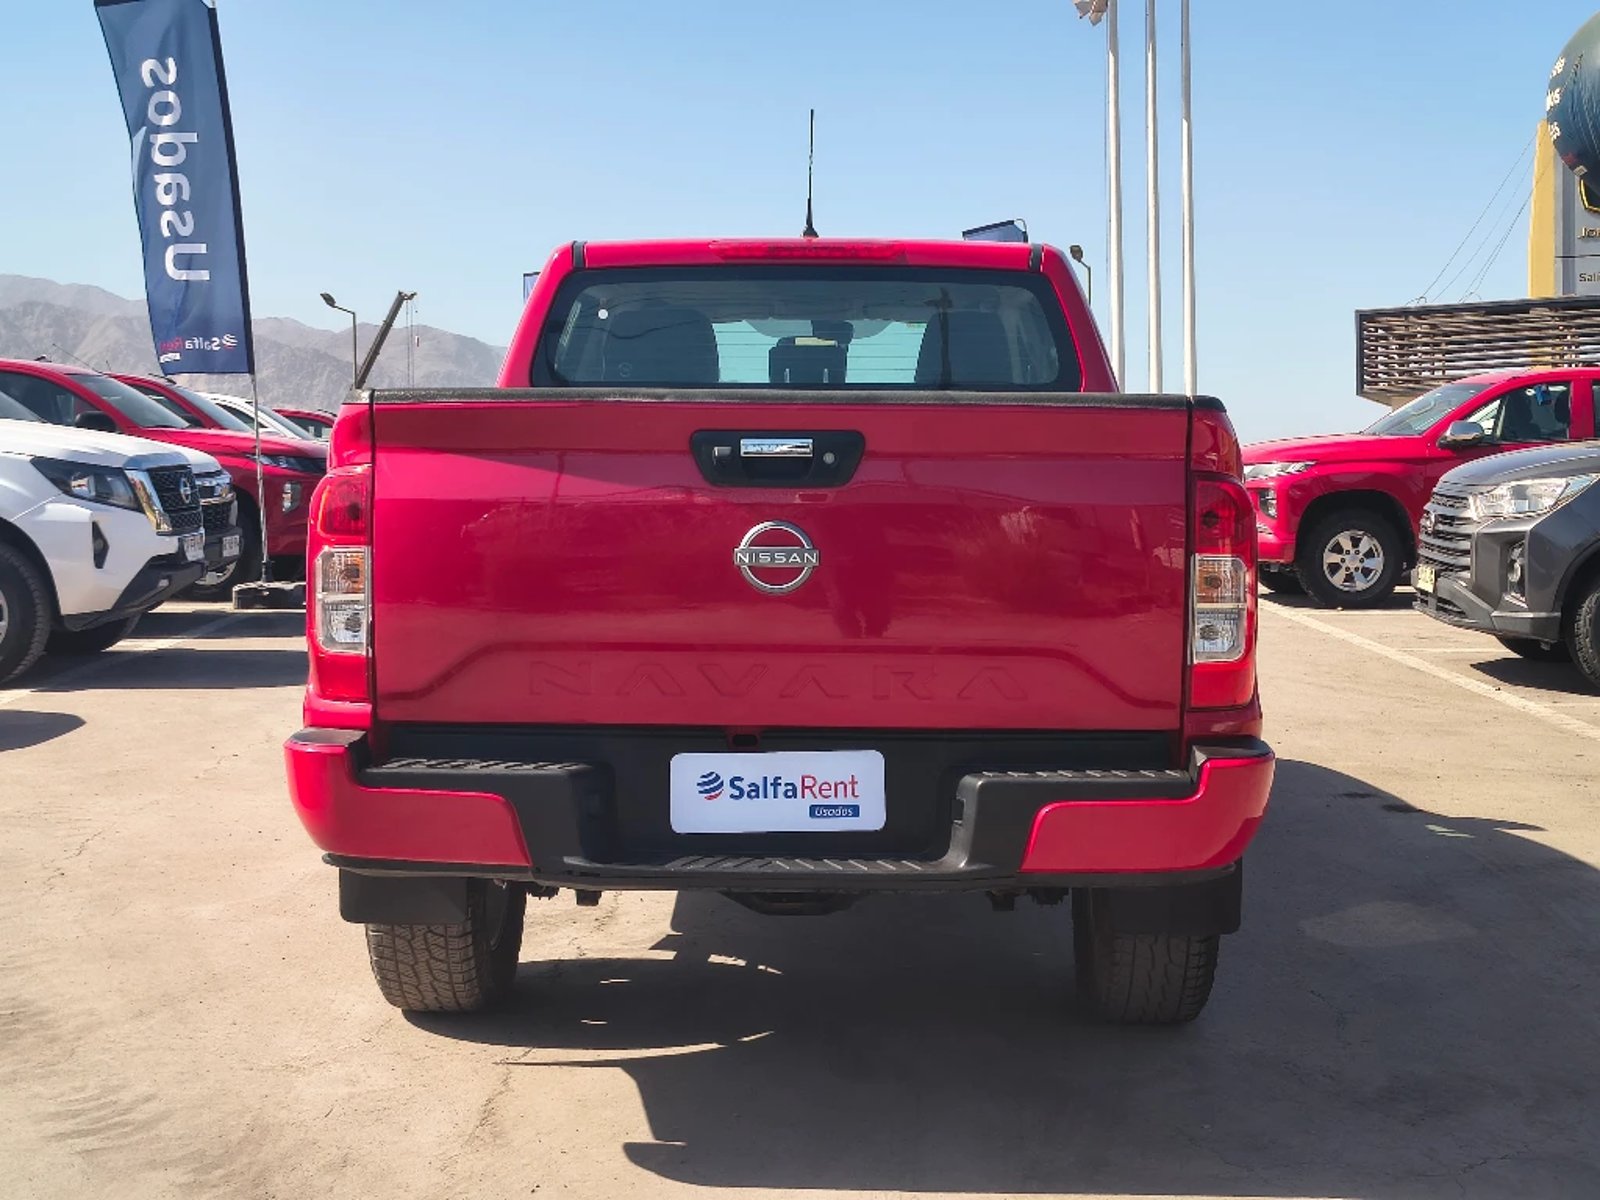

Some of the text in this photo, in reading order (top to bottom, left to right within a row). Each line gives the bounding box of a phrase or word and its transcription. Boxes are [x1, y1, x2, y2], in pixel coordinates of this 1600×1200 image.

[736, 552, 817, 563] NISSAN
[528, 661, 1028, 700] NAVARA
[729, 774, 859, 800] SalfaRent
